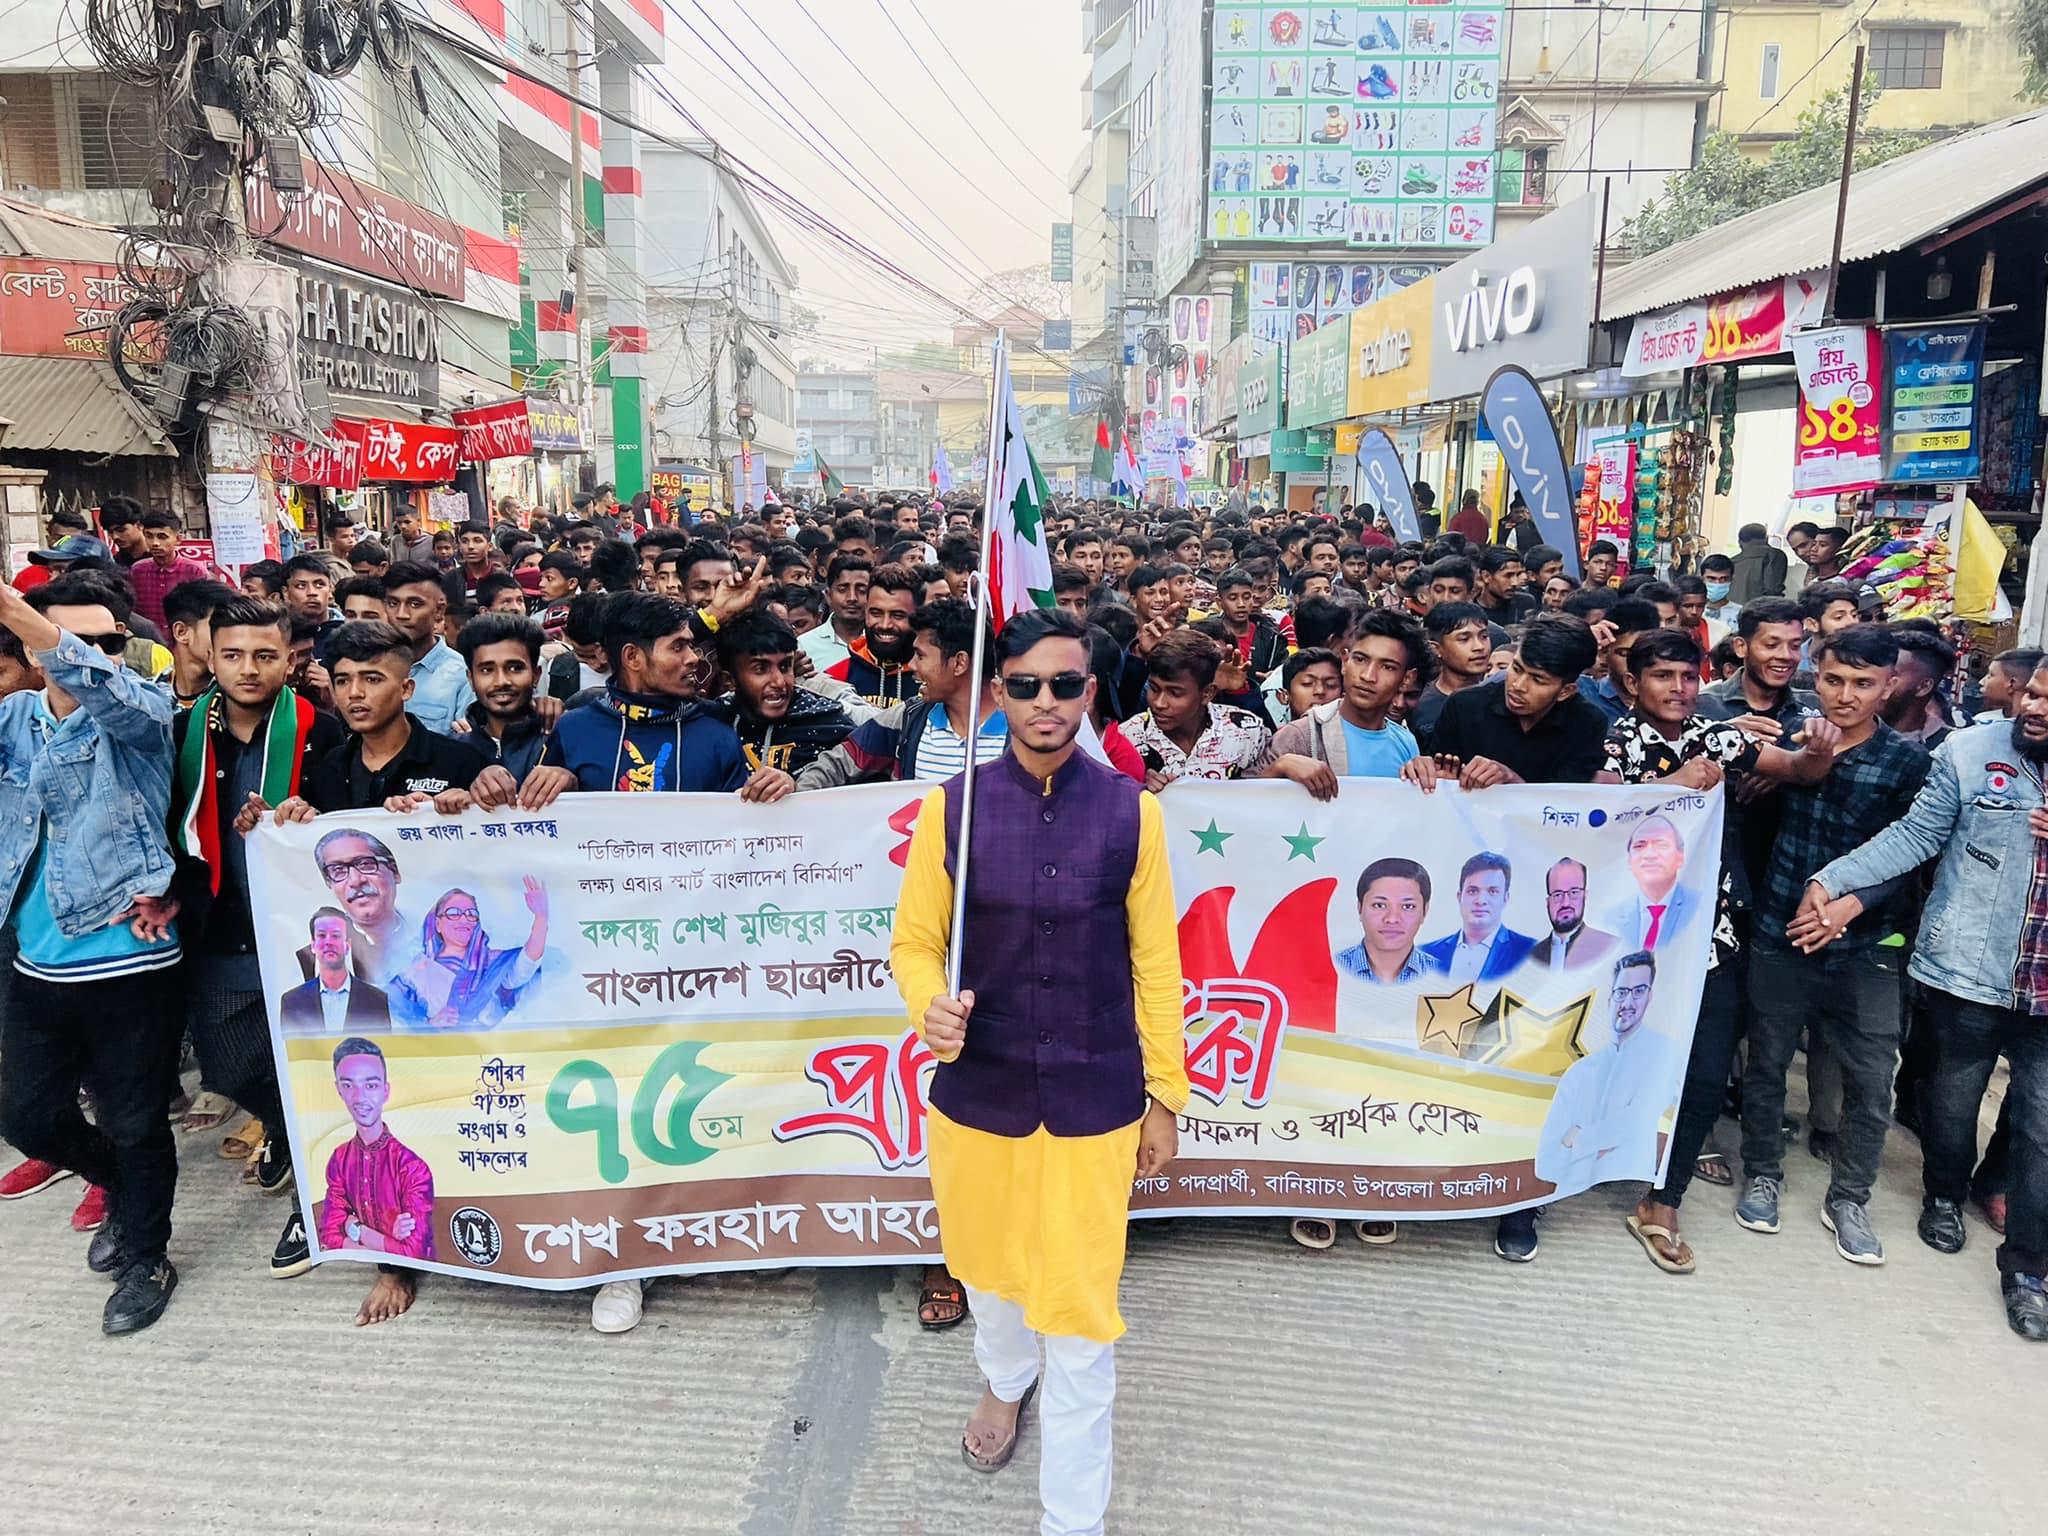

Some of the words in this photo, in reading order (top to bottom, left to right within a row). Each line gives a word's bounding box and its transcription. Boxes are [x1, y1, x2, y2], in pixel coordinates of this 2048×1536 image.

[341, 288, 441, 363] FASHION
[1445, 265, 1541, 353] vivo
[1359, 327, 1412, 379] realme
[337, 359, 420, 398] COLLECTION
[652, 473, 681, 488] BAG
[398, 827, 423, 842] জয়
[426, 825, 464, 841] বাংলা
[481, 822, 507, 838] জয়
[511, 820, 558, 838] বঙ্গবন্ধু
[1542, 805, 1580, 828] শিক্ষা
[659, 838, 736, 859] বাংলাদেশ
[742, 834, 803, 859] দৃশ্যমান
[578, 877, 615, 894] লক্ষ্য
[621, 876, 662, 893] এবার
[669, 868, 705, 891] স্মার্ট
[711, 870, 786, 890] বাংলাদেশ
[579, 918, 662, 955] বঙ্গবন্ধু
[673, 911, 728, 945] শেখ
[736, 902, 828, 946] মুজিবুর
[582, 960, 751, 1006] বাংলাদেশ
[514, 1117, 527, 1138] ও
[545, 1040, 737, 1184] ৭৫
[698, 1116, 744, 1139] তম
[1271, 1119, 1300, 1140] ও
[1310, 1094, 1400, 1139] স্বার্থক
[1408, 1101, 1483, 1136] হোক
[1178, 1168, 1256, 1196] পদপ্রার্থী,
[1264, 1171, 1347, 1198] বানিয়াচং
[1352, 1174, 1434, 1199] উপজেলা
[1440, 1172, 1508, 1199] ছাত্রলীগ
[516, 1215, 623, 1265] শেখ
[633, 1201, 806, 1254] ফরহাদ
